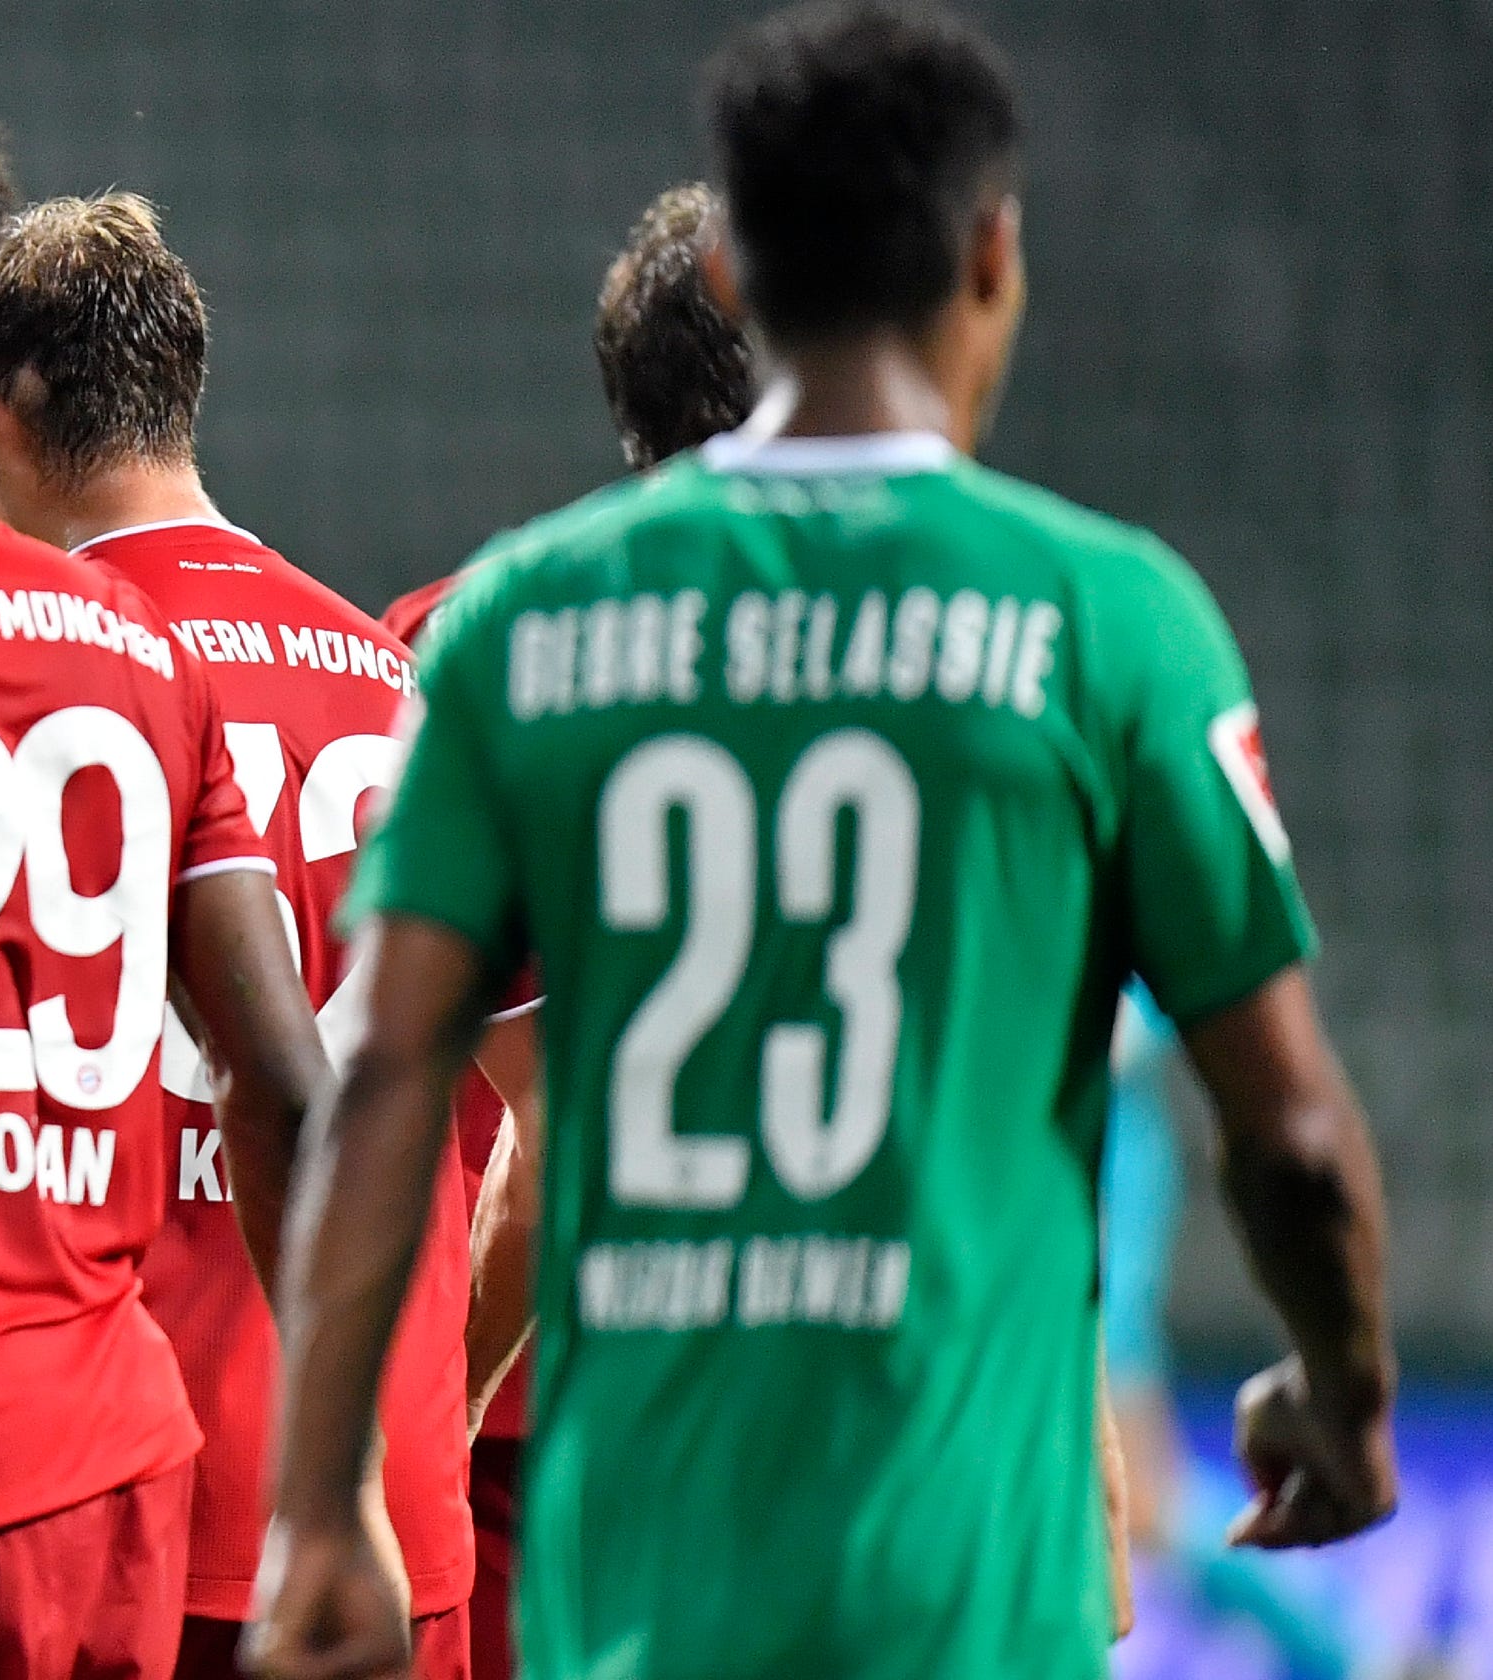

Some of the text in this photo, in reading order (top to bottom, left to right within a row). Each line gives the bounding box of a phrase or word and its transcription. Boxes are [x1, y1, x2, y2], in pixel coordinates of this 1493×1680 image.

[168, 618, 418, 699] YERN MÜNCH
[599, 728, 922, 1209] 23
